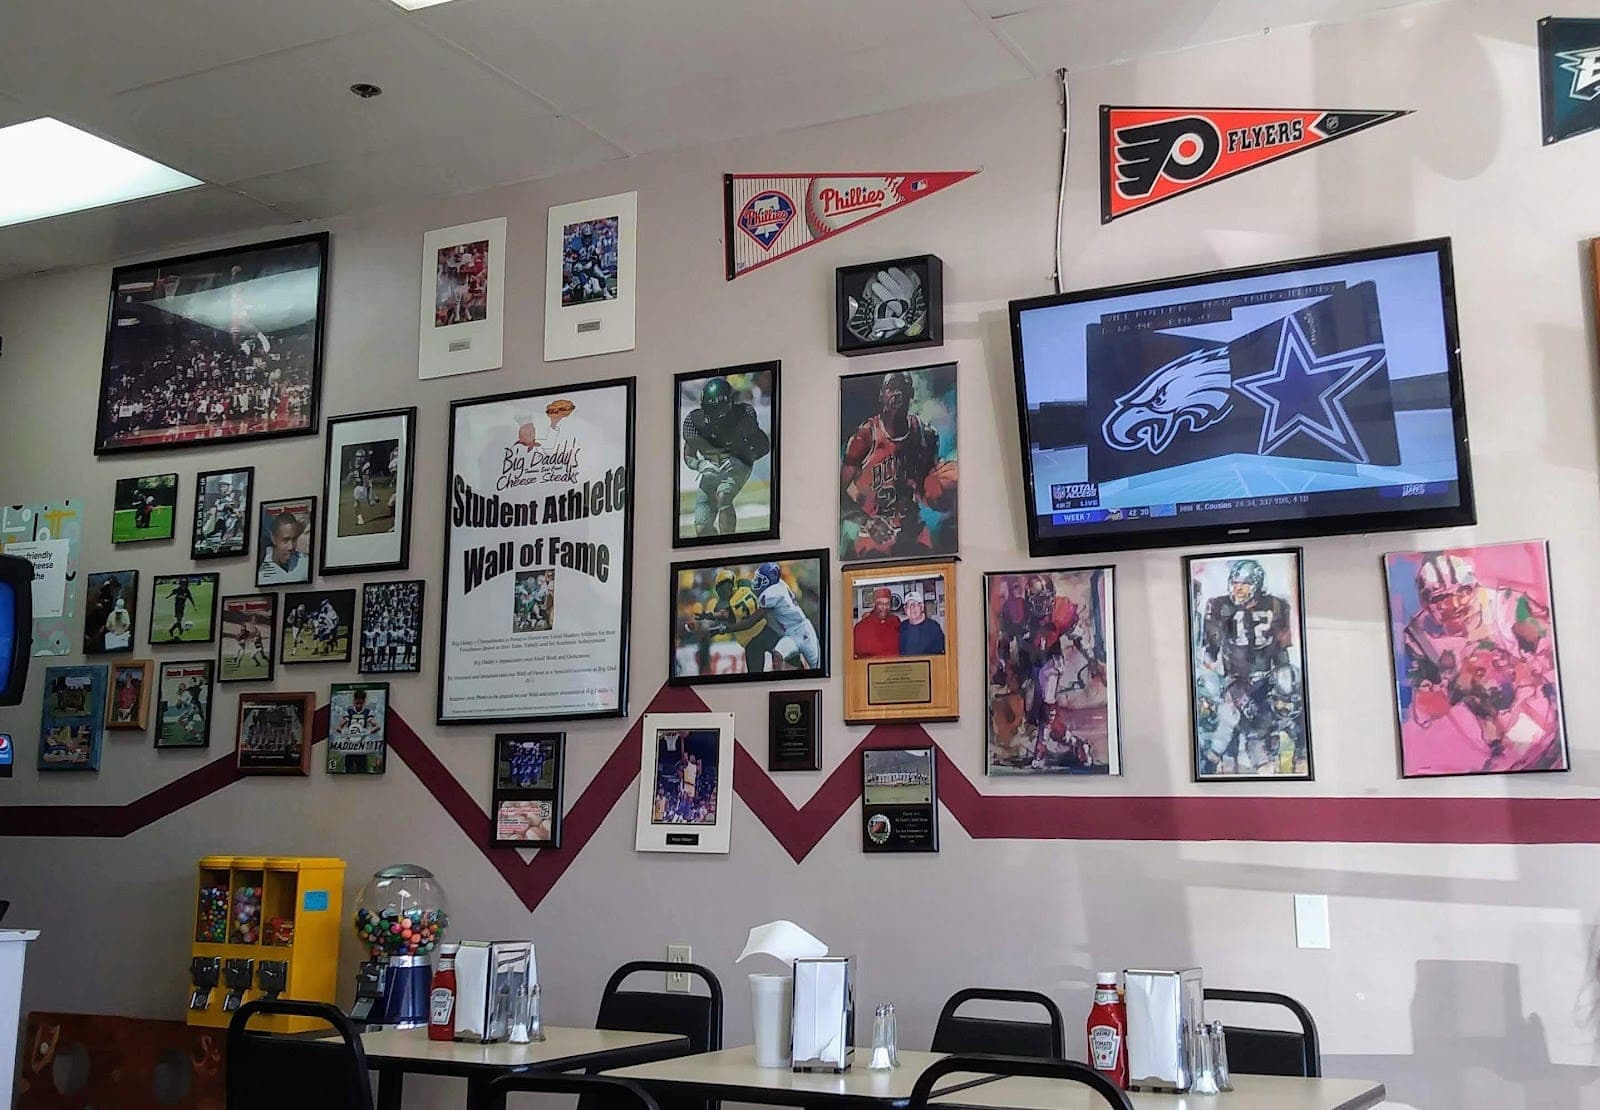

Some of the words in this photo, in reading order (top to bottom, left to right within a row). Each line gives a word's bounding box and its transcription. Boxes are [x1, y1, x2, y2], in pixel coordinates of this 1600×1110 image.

[1227, 119, 1303, 153] FLYERS
[819, 186, 885, 213] Phillies
[745, 208, 787, 226] Phillies
[503, 447, 525, 478] Big
[530, 437, 581, 474] Daddy's
[496, 473, 537, 491] Cheese
[540, 471, 580, 484] Steaks
[1065, 484, 1097, 493] TOTAL
[453, 474, 538, 528] Student
[541, 466, 626, 524] Athlete
[1204, 501, 1232, 511] Cousins
[1063, 513, 1085, 522] WEEK
[34, 562, 54, 570] heese
[463, 541, 514, 596] Wall
[519, 538, 544, 567] of
[549, 537, 610, 584] Fame
[1231, 610, 1274, 646] 12
[329, 741, 365, 751] MADDEN
